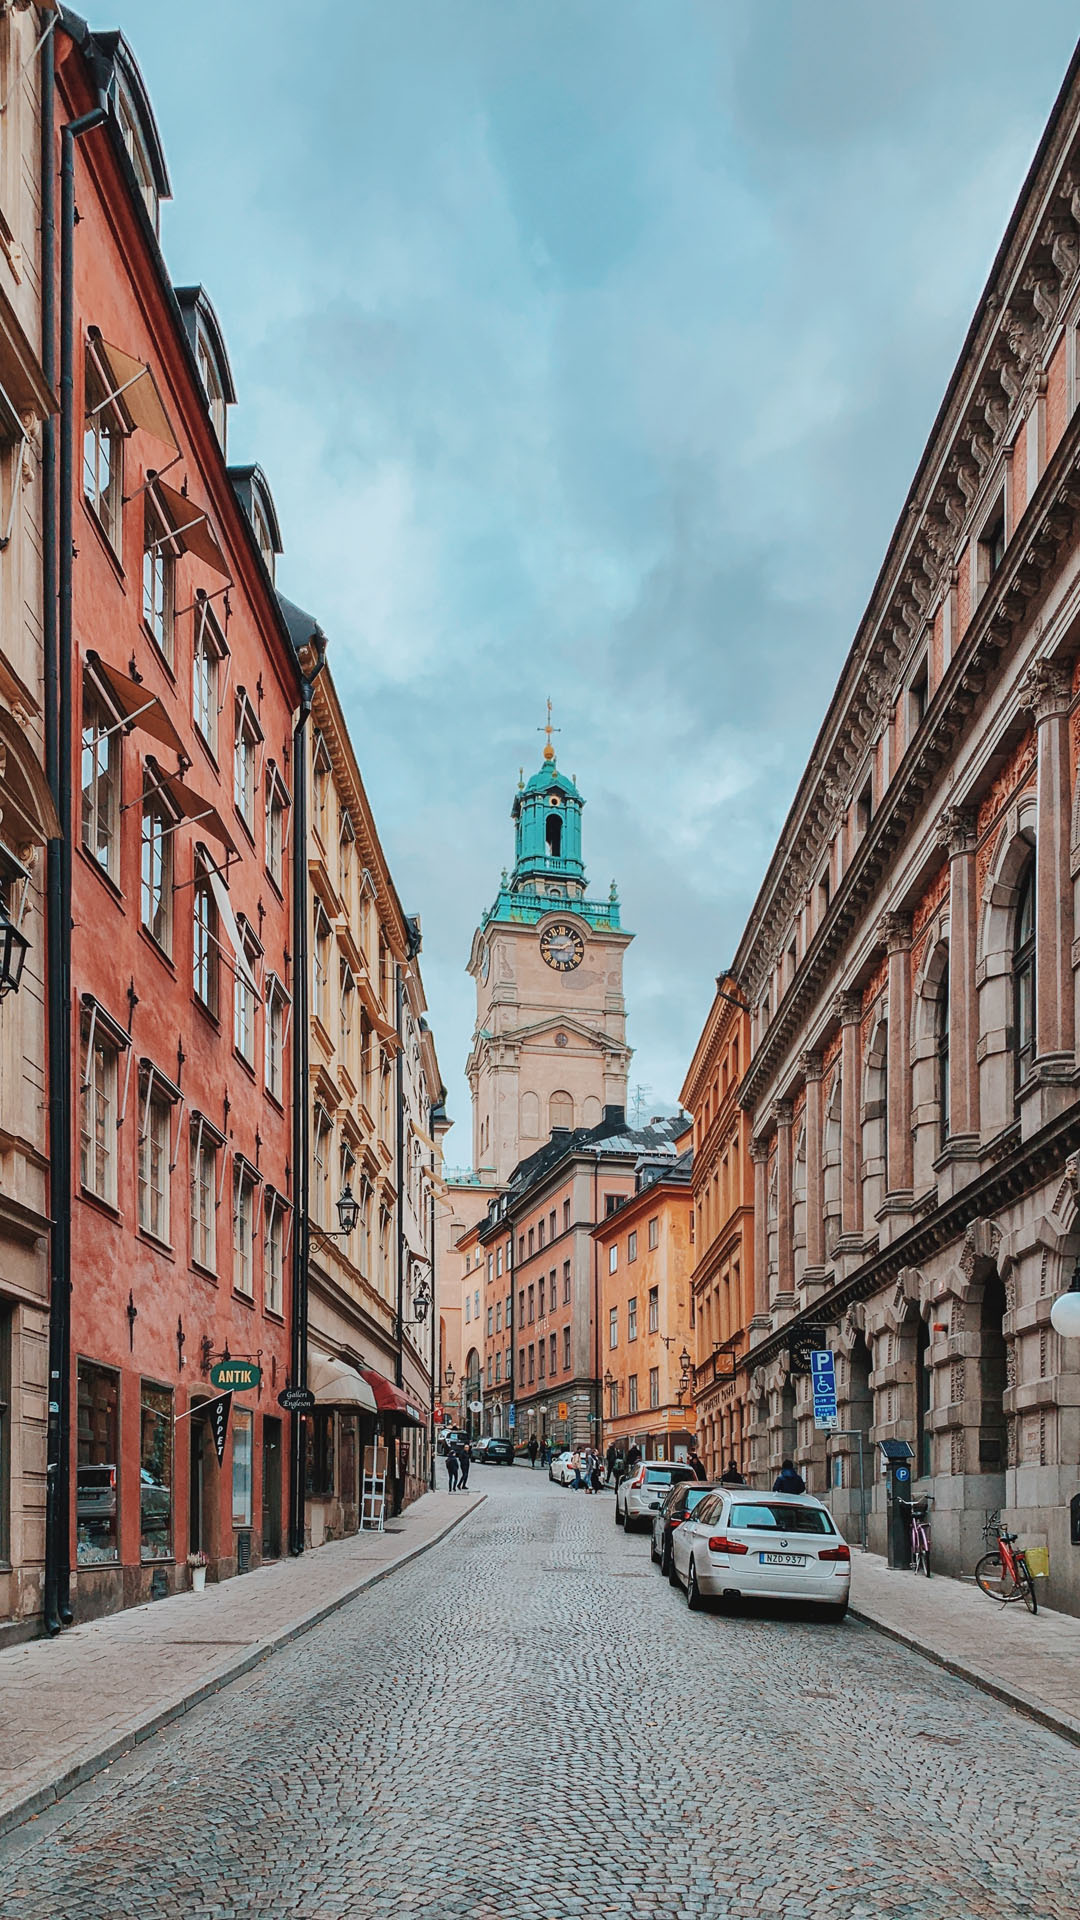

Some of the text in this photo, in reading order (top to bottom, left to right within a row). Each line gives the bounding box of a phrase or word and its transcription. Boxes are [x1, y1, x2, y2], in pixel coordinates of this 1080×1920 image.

[816, 1353, 830, 1371] P
[218, 1370, 252, 1383] ANTIK
[286, 1391, 307, 1399] Galleri
[282, 1399, 311, 1410] Engleson
[216, 1403, 224, 1456] ÖPPET
[900, 1470, 907, 1479] P
[785, 1555, 802, 1563] 937
